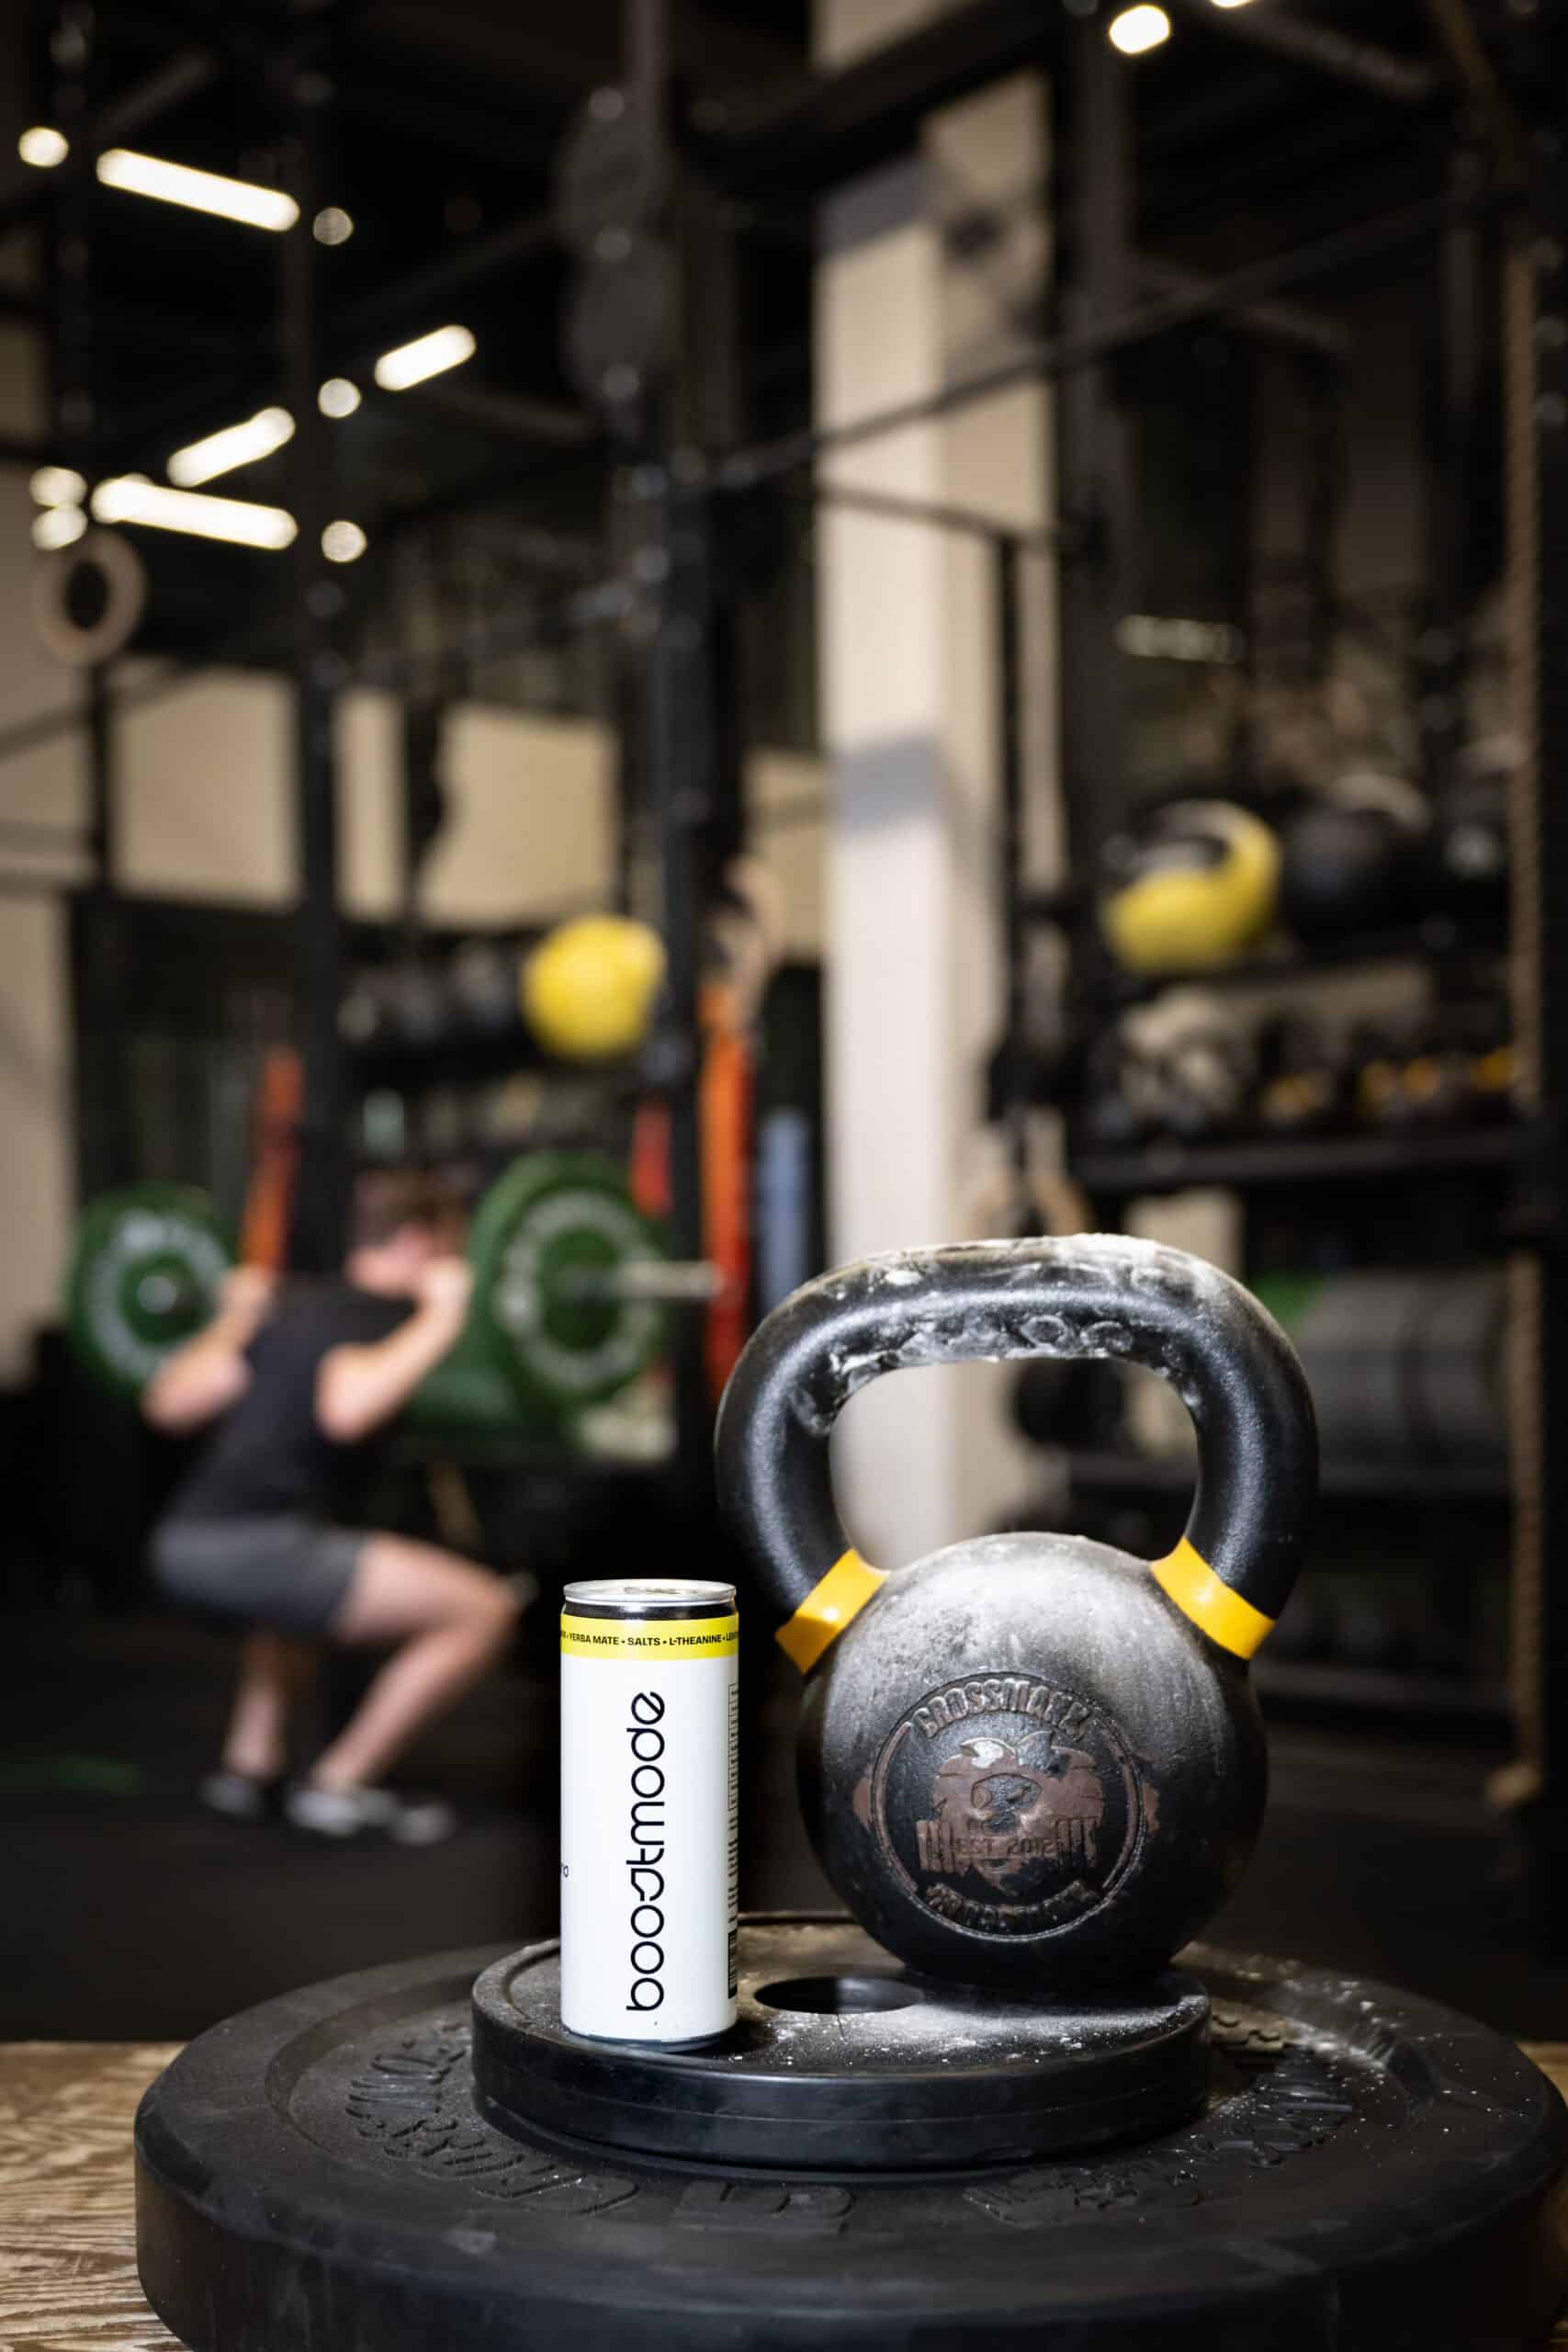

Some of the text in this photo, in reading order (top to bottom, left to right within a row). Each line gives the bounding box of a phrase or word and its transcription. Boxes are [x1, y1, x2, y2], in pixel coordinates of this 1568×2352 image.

[569, 1631, 591, 1643] YERBA
[592, 1635, 619, 1645] MATE
[627, 1636, 660, 1646] SALTS
[669, 1633, 722, 1646] L-THEANINE
[626, 1691, 665, 2011] boostmode
